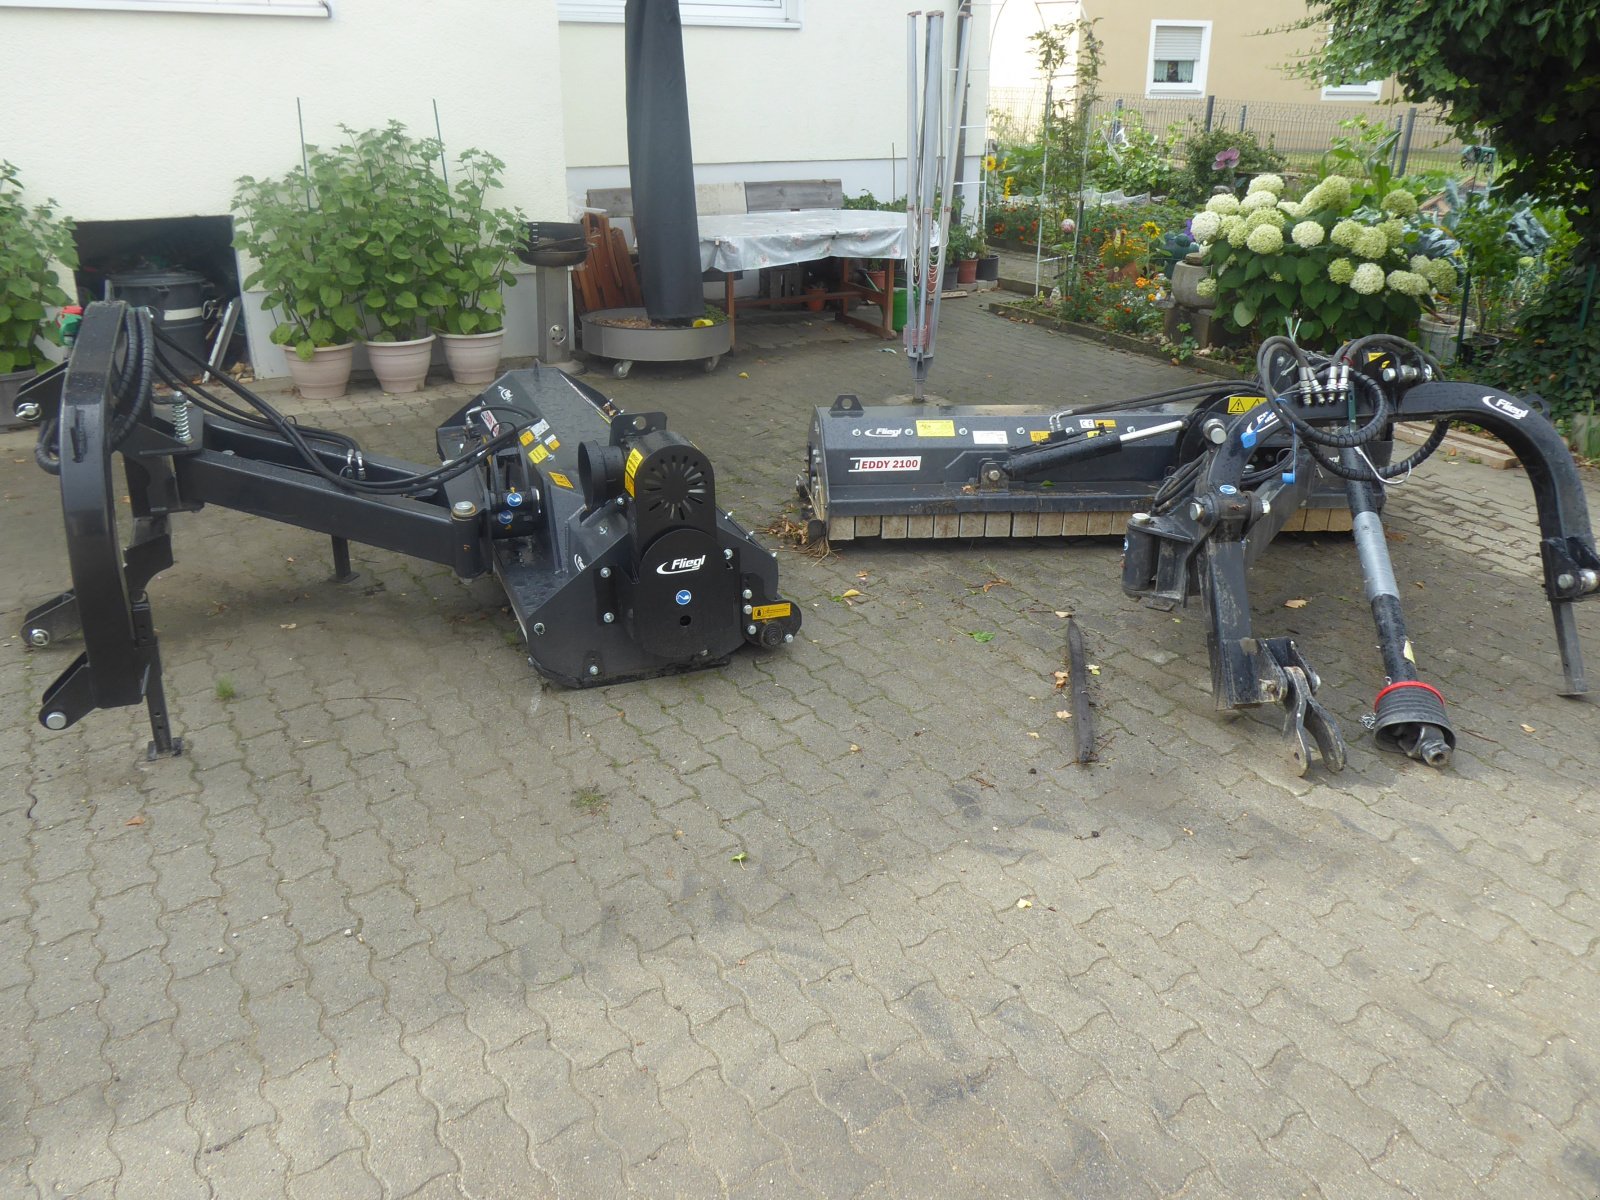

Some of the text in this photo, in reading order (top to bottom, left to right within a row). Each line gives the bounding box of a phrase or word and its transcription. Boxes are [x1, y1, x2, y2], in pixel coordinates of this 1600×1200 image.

[1495, 398, 1529, 419] Fliegl
[875, 428, 902, 437] Fliegl
[892, 460, 918, 469] 2100
[671, 554, 707, 570] Fliegl
